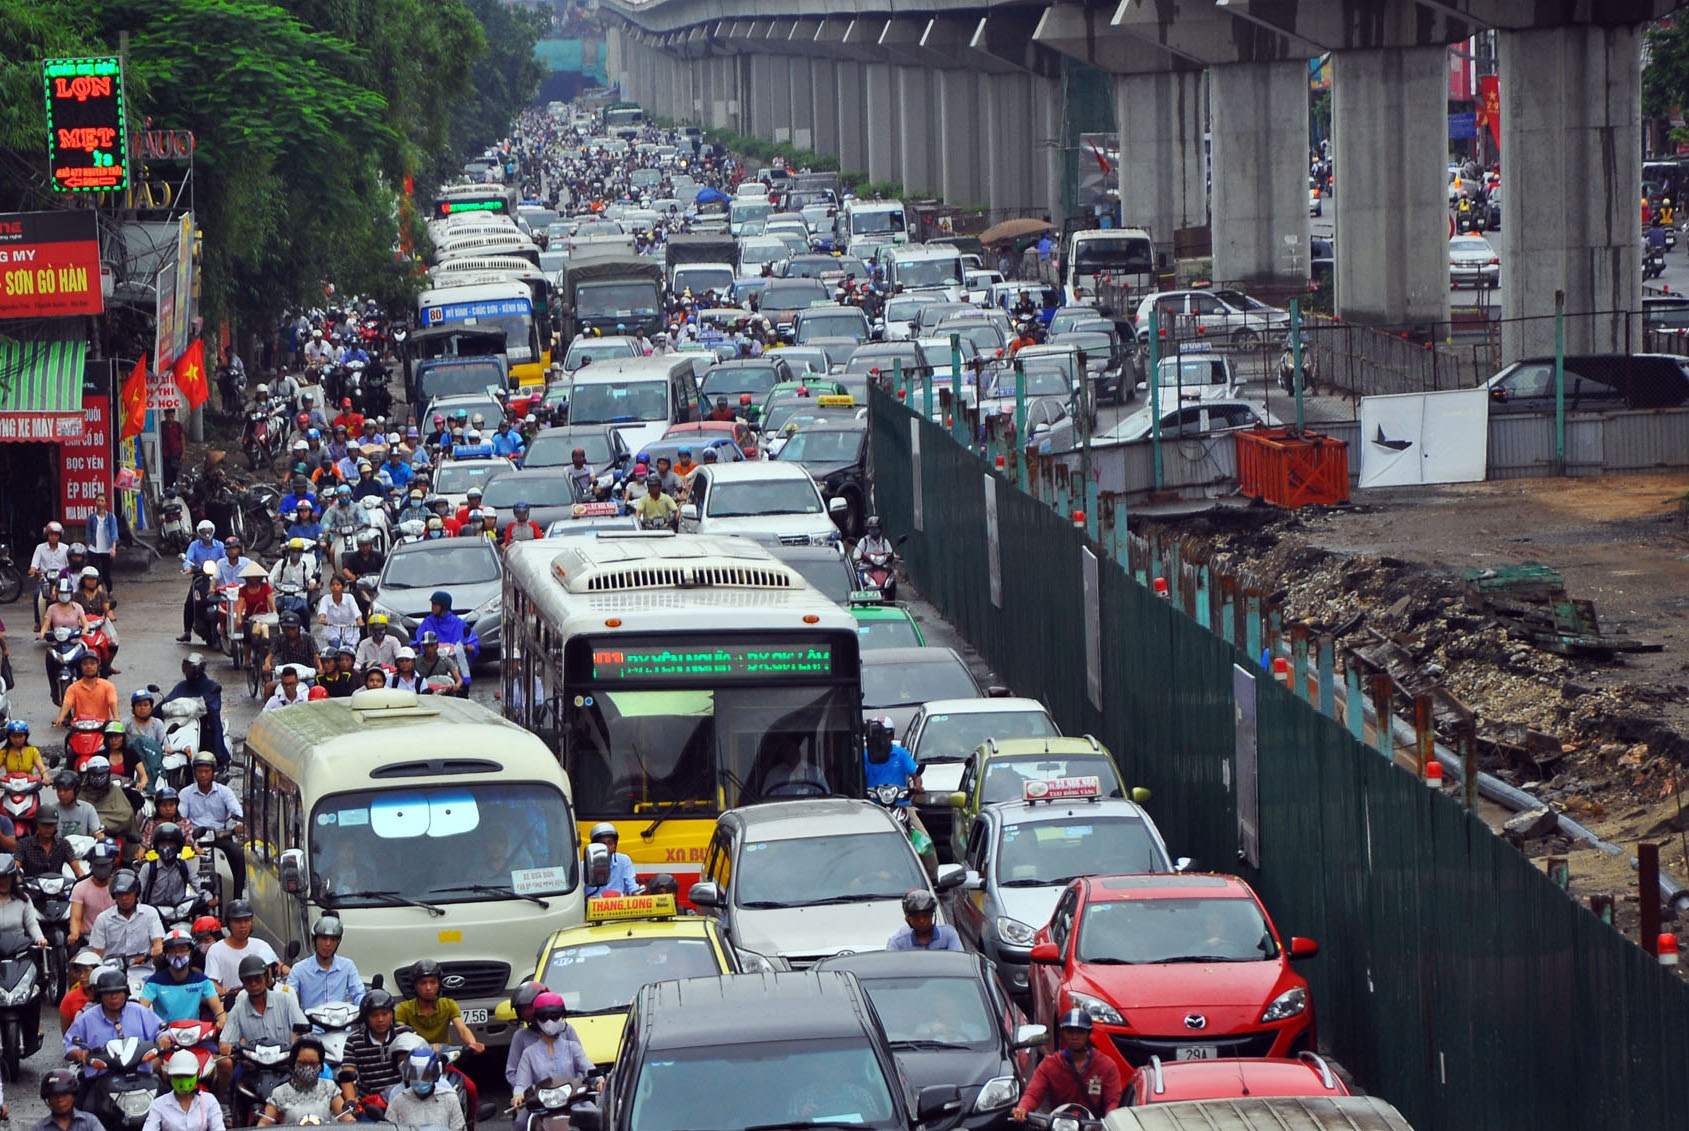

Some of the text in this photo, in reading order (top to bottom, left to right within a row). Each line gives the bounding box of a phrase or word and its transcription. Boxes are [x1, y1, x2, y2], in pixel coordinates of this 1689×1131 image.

[13, 249, 36, 262] MY
[5, 263, 88, 295] SƠN GÒ HÀN
[158, 388, 174, 396] THI
[18, 418, 31, 437] XE
[32, 415, 54, 437] MÁY
[66, 455, 104, 472] BỌC YÊN
[67, 478, 79, 499] ÉP
[626, 898, 652, 910] LONG
